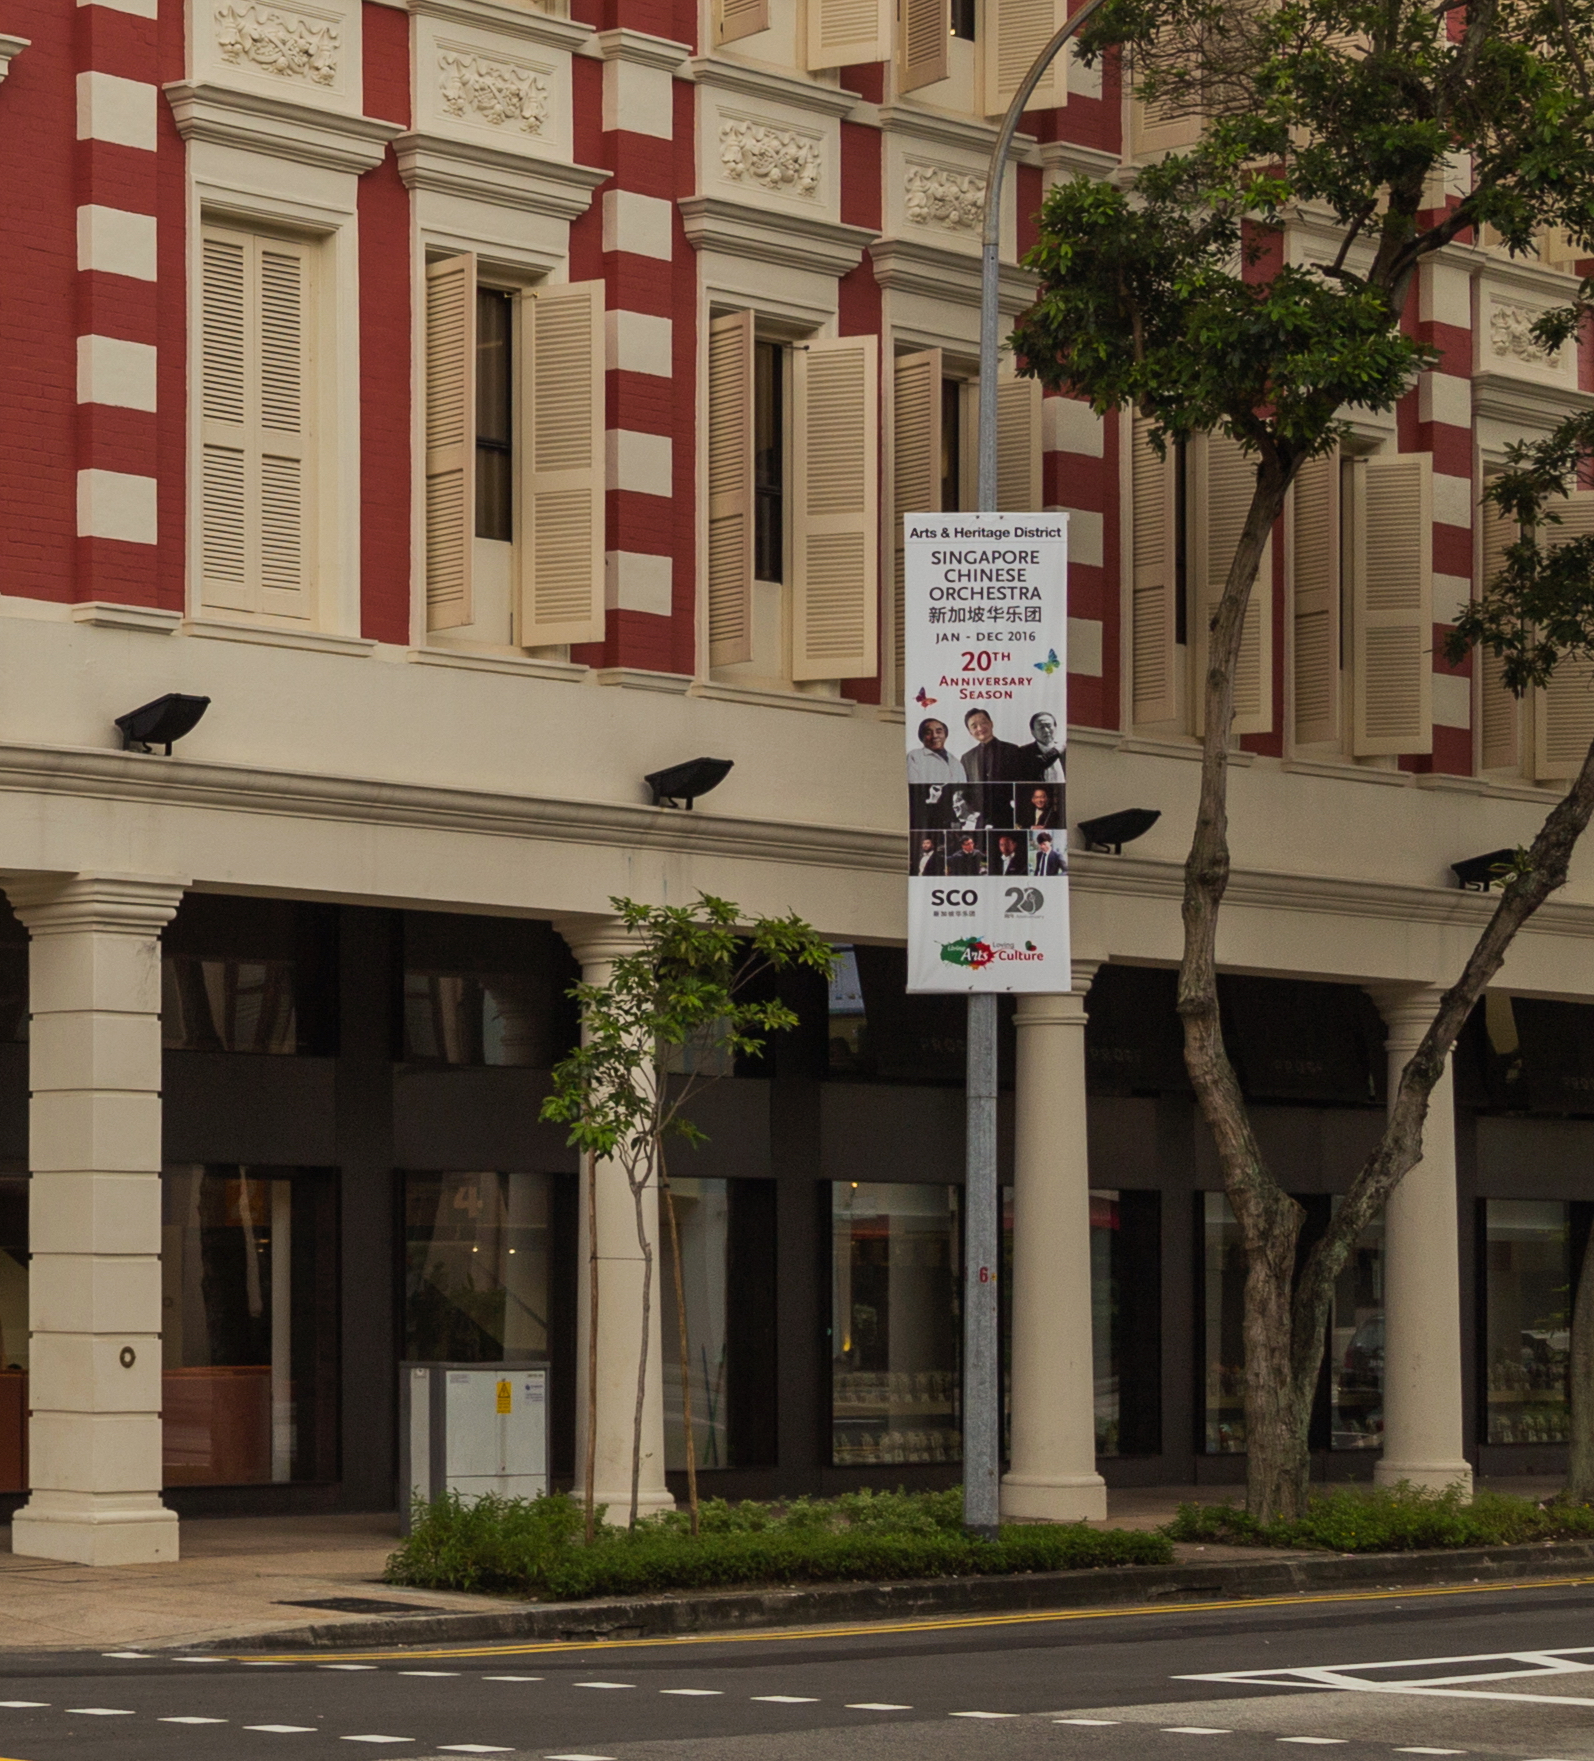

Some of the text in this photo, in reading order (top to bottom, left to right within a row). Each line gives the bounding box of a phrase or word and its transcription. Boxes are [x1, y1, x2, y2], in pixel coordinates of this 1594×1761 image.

[910, 526, 1061, 541] Arts & Heritage District
[931, 550, 1040, 565] SINGAPORE
[944, 568, 1027, 583] CHINESE
[929, 586, 1042, 601] ORCHESTRA
[928, 606, 1042, 624] 新加坡华乐团
[935, 631, 960, 644] JAN
[976, 631, 1003, 642] DEC
[1007, 631, 1036, 642] 2016
[939, 675, 1033, 687] ANNIVERSARY
[959, 688, 1013, 700] SEASON
[931, 889, 978, 907] SCO
[1004, 887, 1044, 914] 20
[992, 941, 1015, 950] Loving
[960, 947, 989, 961] Arts
[998, 949, 1044, 961] Culture
[979, 1266, 989, 1283] 6
